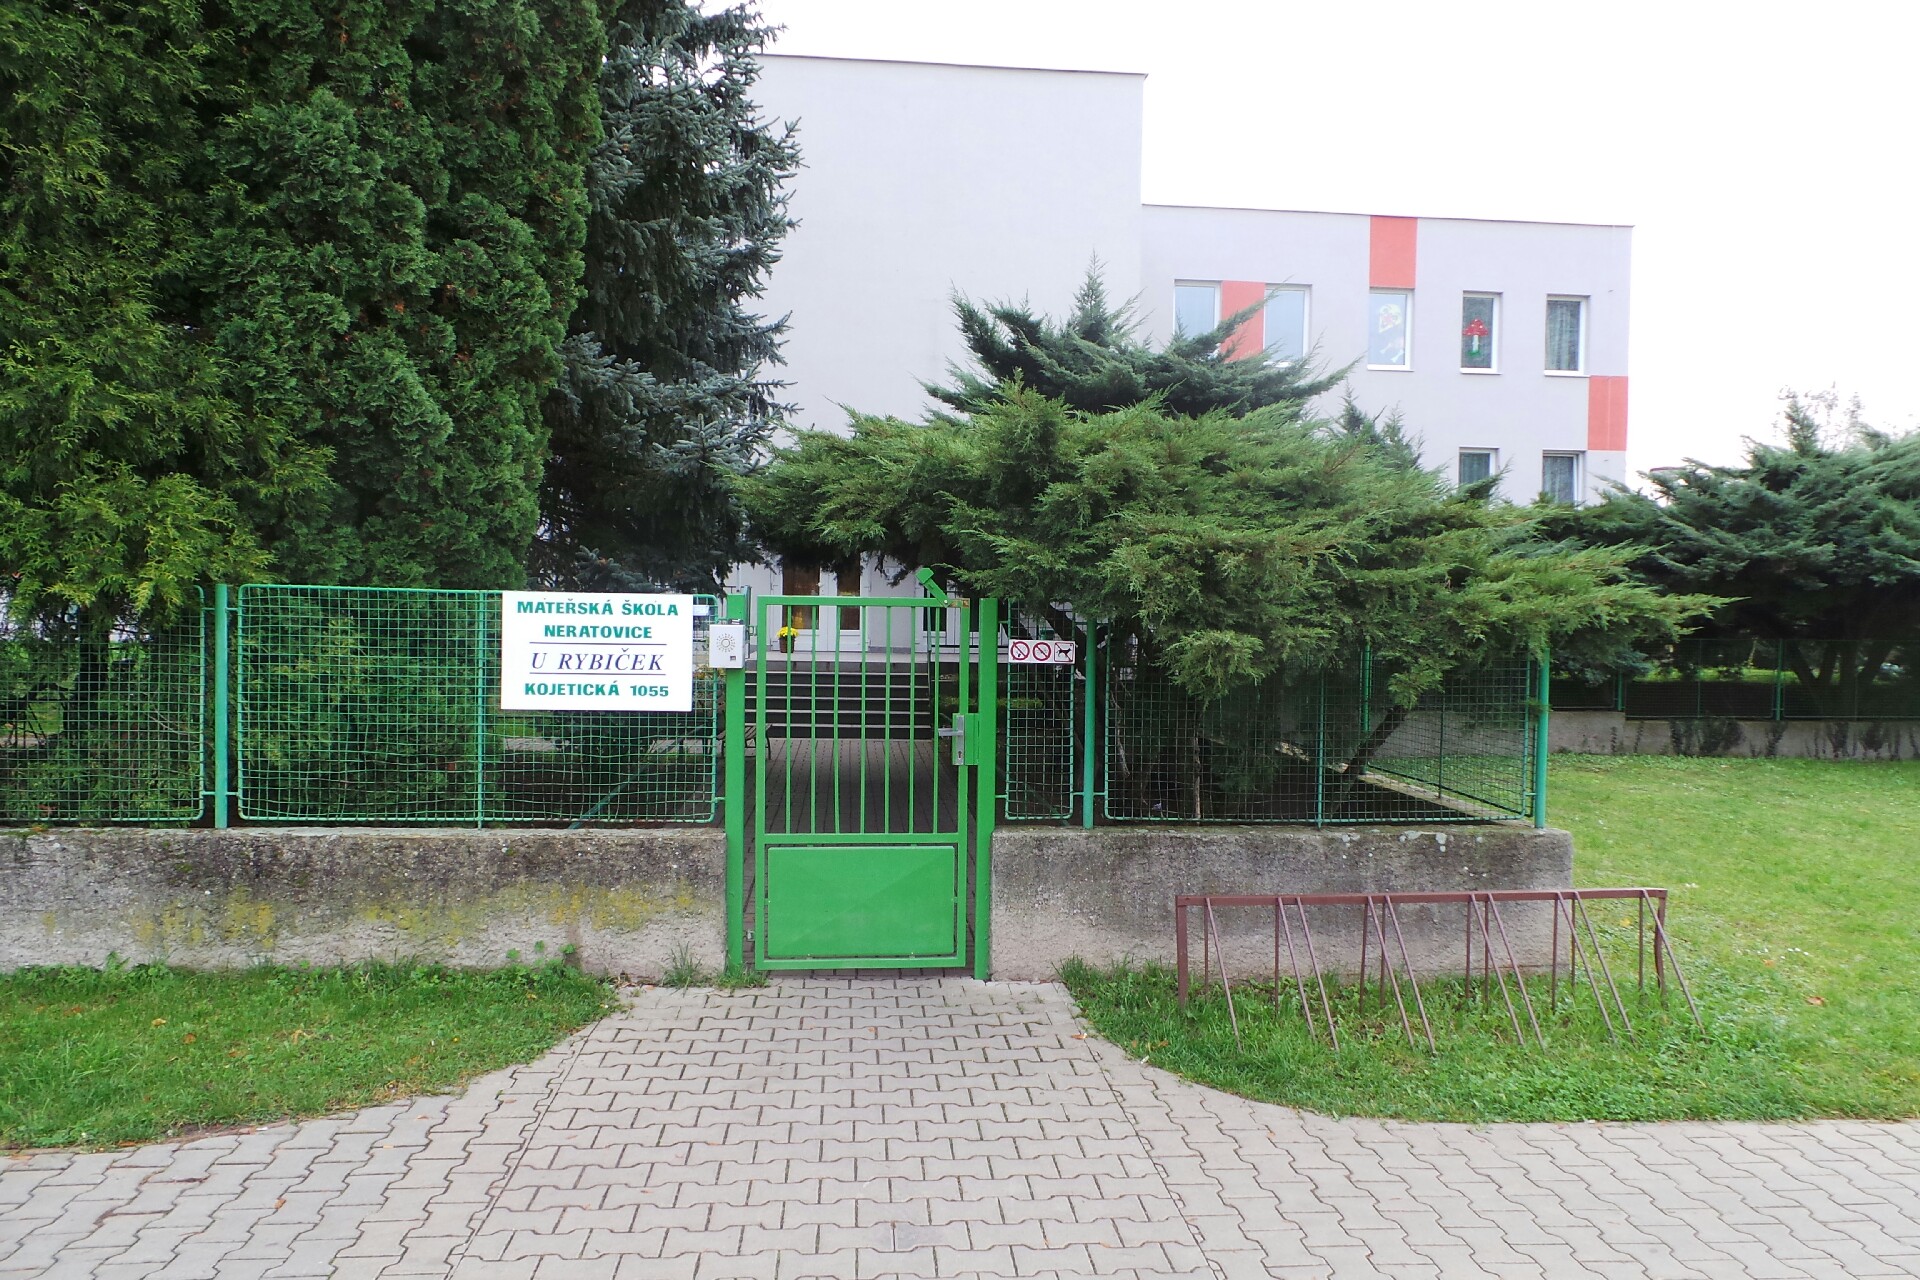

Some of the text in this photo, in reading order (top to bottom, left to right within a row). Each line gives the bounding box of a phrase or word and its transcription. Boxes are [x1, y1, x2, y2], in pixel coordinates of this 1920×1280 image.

[517, 598, 679, 617] MATEŘSKÁ ŠKOLA
[544, 625, 653, 639] NERATOVICE
[531, 647, 664, 671] U RYBIČEK
[524, 681, 669, 698] KOJETICKÁ 1055
